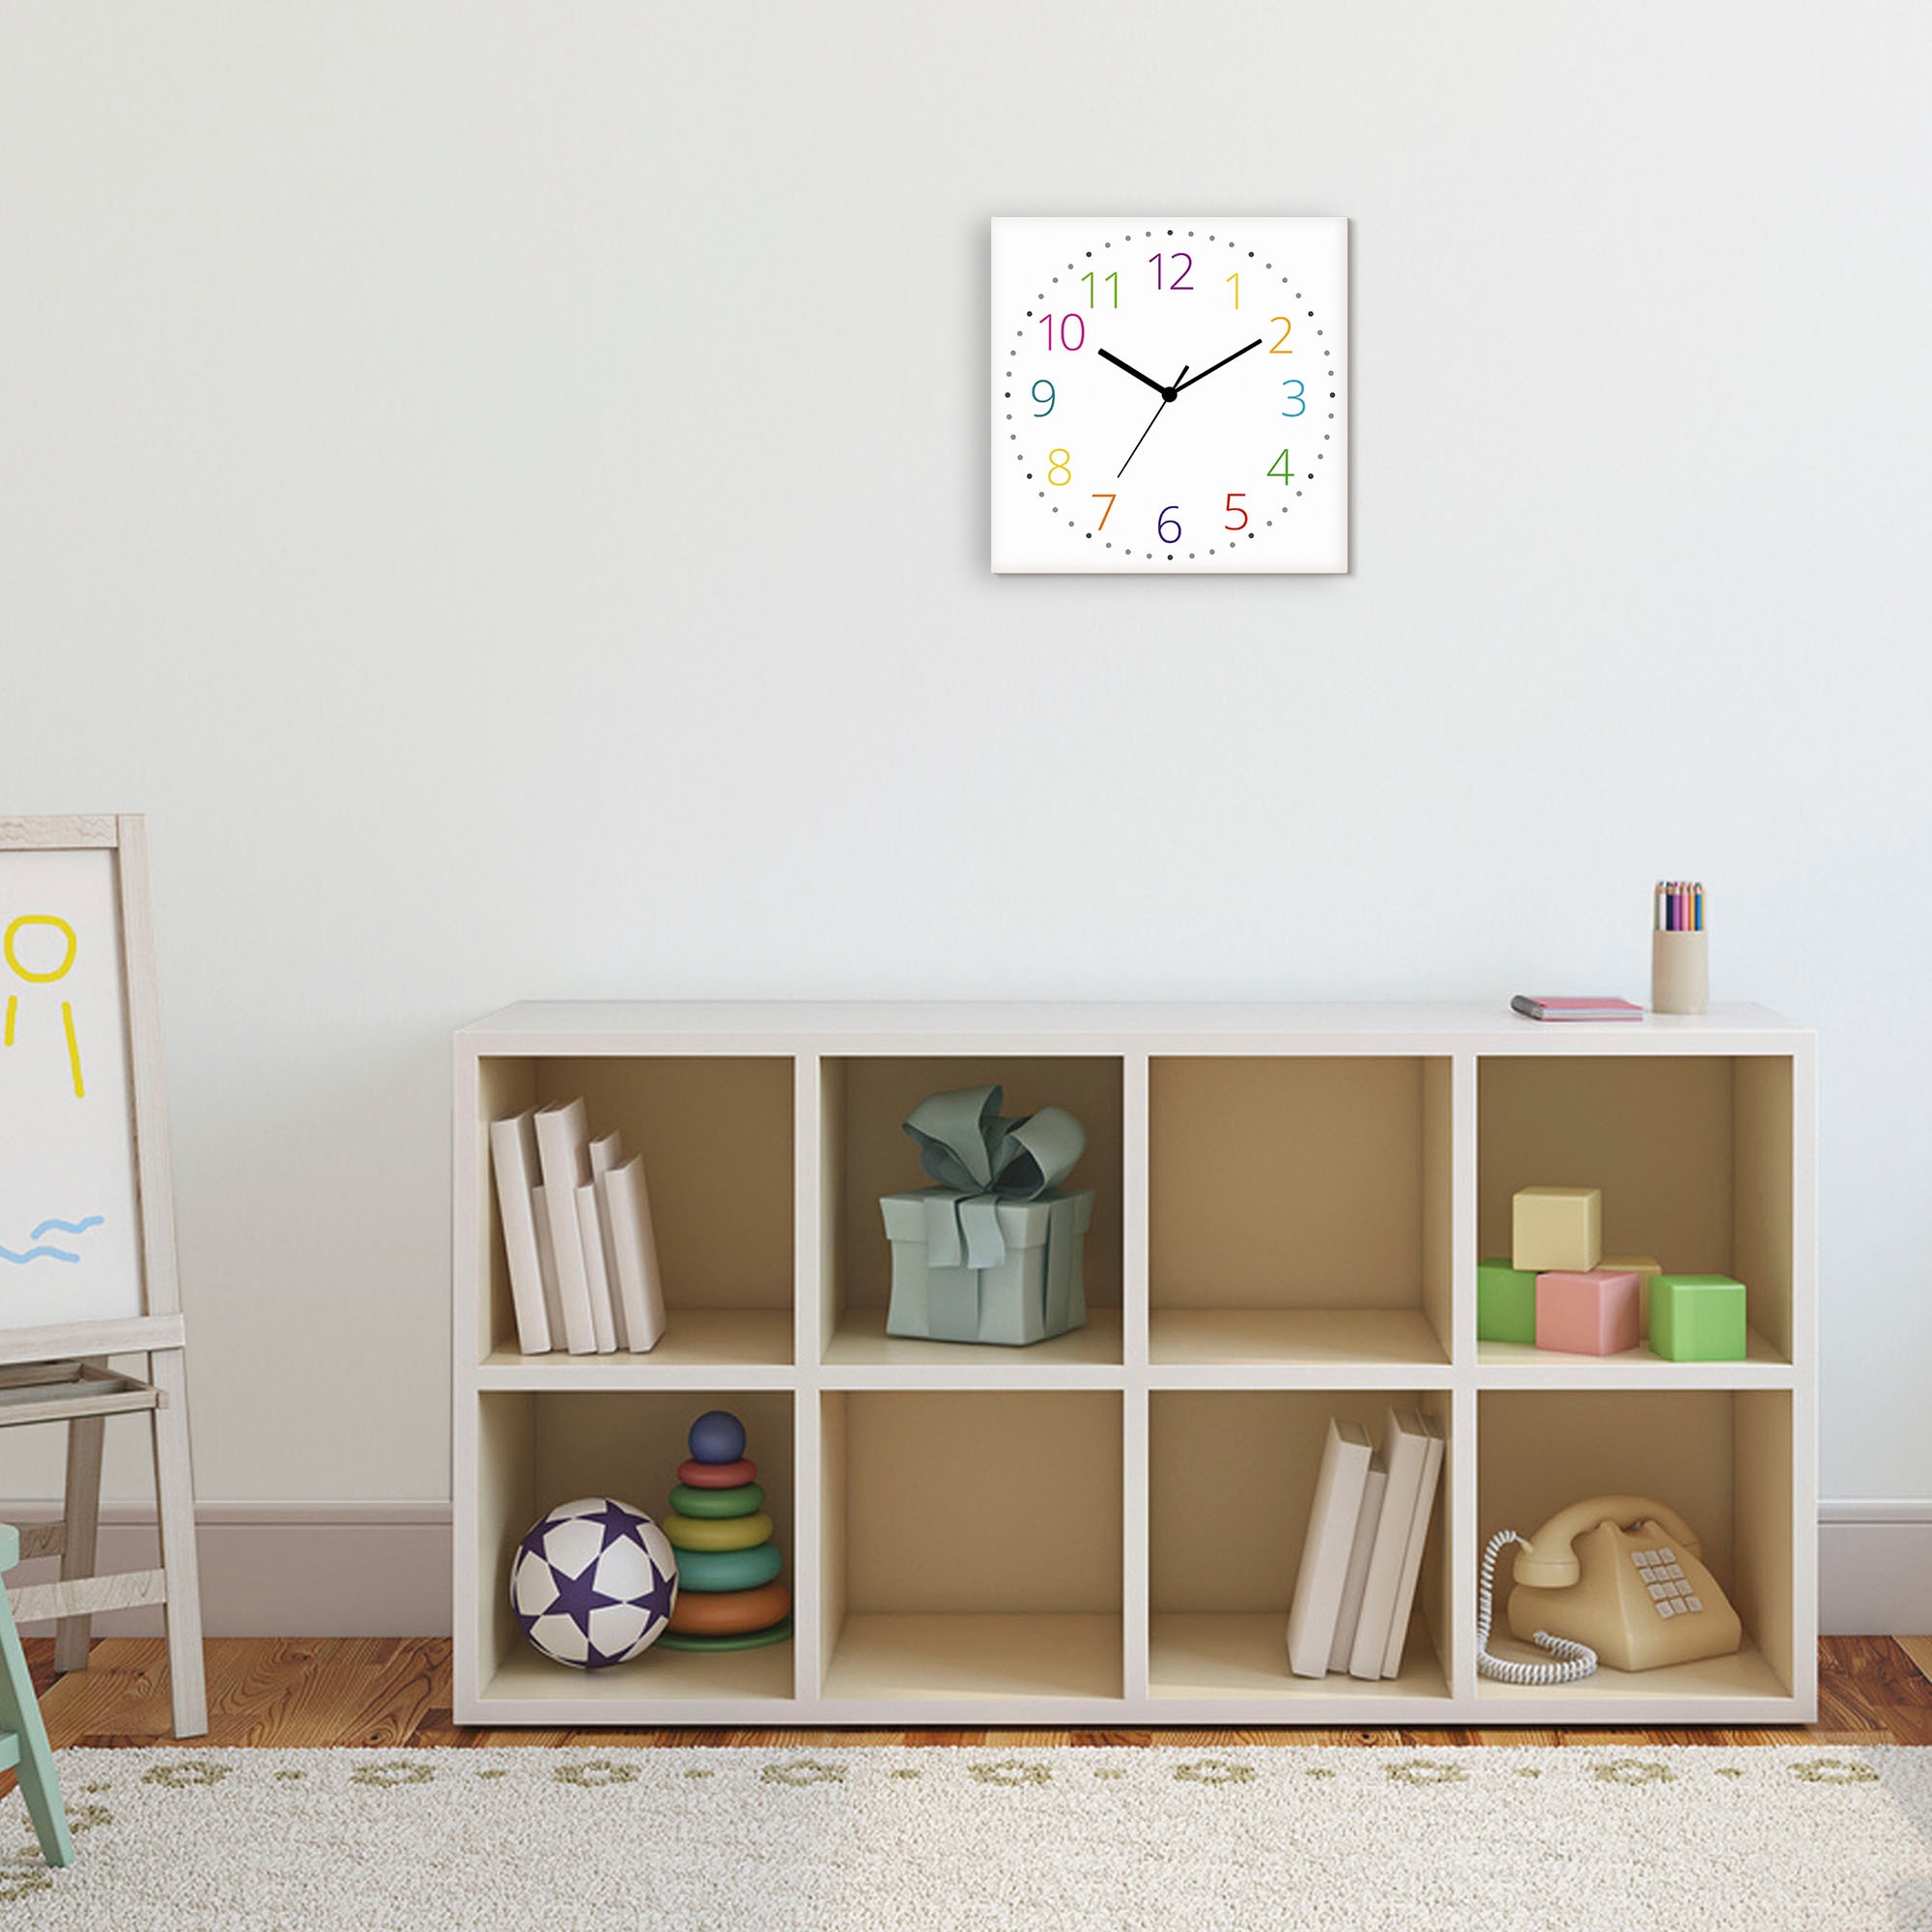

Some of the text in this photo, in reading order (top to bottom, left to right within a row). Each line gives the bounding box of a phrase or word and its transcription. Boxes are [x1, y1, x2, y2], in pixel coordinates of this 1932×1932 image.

[1081, 271, 1118, 309] 11
[1149, 252, 1194, 291] 12
[1226, 272, 1239, 310] 1
[1039, 313, 1086, 352] 10
[1268, 316, 1293, 355] 2
[1031, 379, 1056, 417] 9
[1281, 379, 1306, 417] 3
[1047, 448, 1072, 487] 8
[1266, 448, 1294, 486] 4
[1092, 494, 1117, 531] 7
[1157, 505, 1182, 544] 6
[1225, 493, 1248, 531] 5
